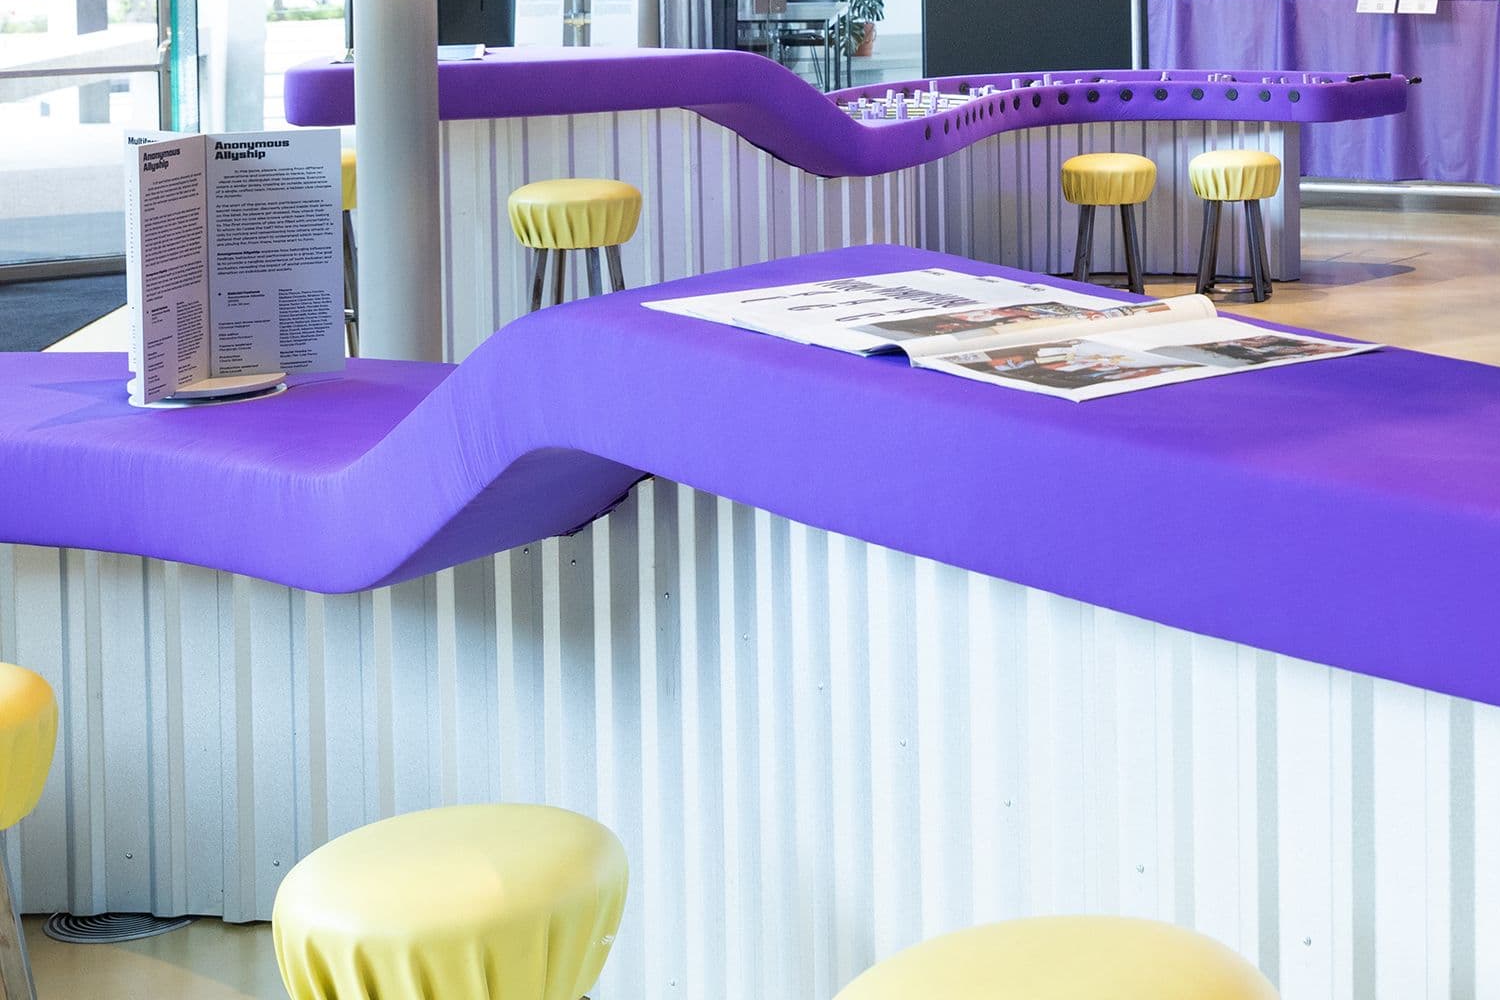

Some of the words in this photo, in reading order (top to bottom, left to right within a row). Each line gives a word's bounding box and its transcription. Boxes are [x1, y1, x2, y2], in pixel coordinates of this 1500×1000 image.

[214, 140, 290, 150] Anonymous
[143, 148, 181, 162] Anonymous
[214, 150, 266, 161] Allyship
[143, 160, 169, 172] Allyship
